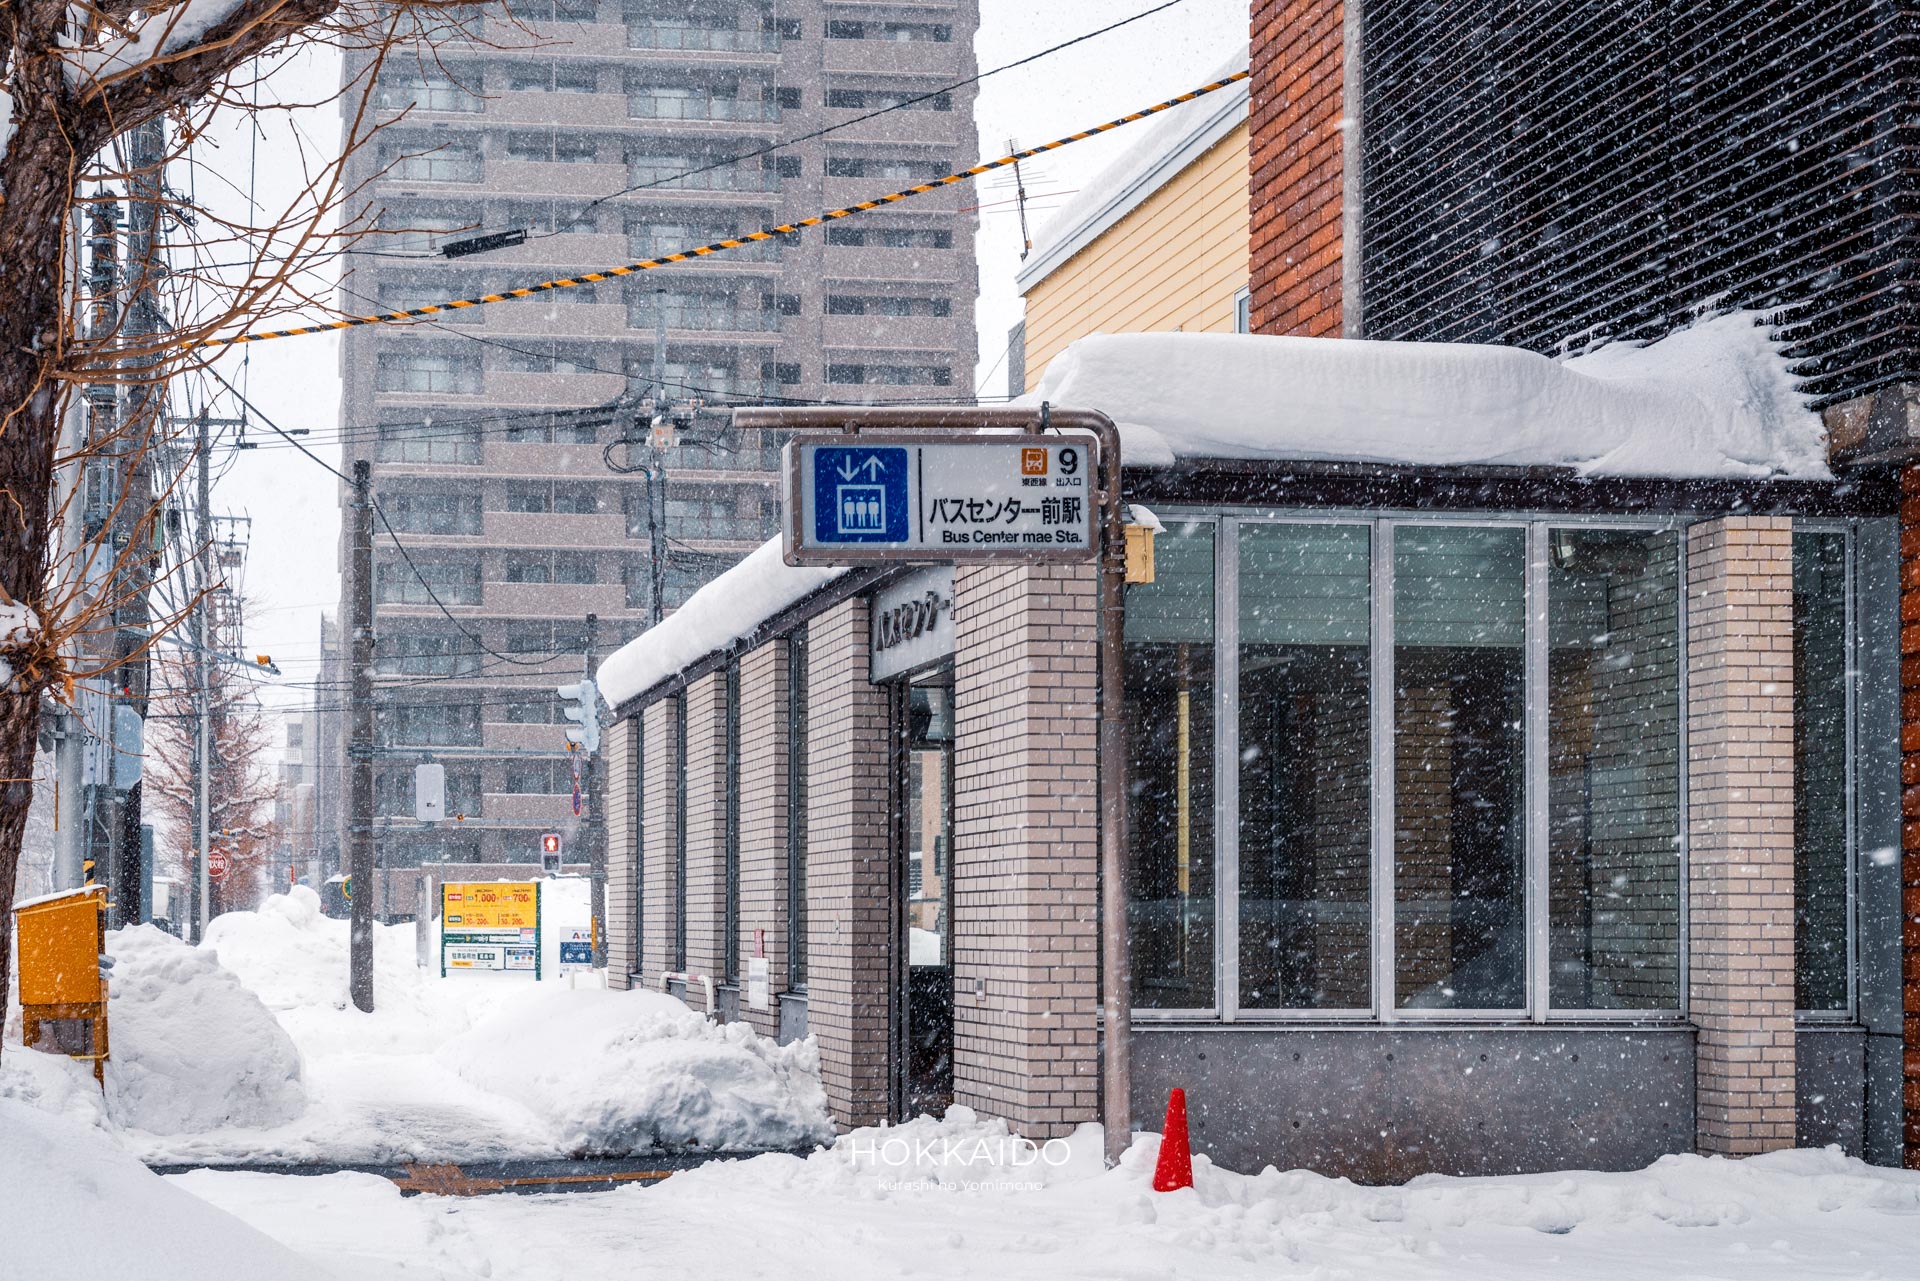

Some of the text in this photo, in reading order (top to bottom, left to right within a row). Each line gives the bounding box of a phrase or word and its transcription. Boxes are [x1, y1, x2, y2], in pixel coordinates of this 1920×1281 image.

[1058, 447, 1078, 475] 9
[1021, 477, 1048, 487] 東西線
[1056, 477, 1082, 487] 出入口
[929, 496, 1082, 526] バスセンター前駅
[942, 530, 1083, 543] Bus Center mae Sta.
[876, 581, 955, 652] バスセンター
